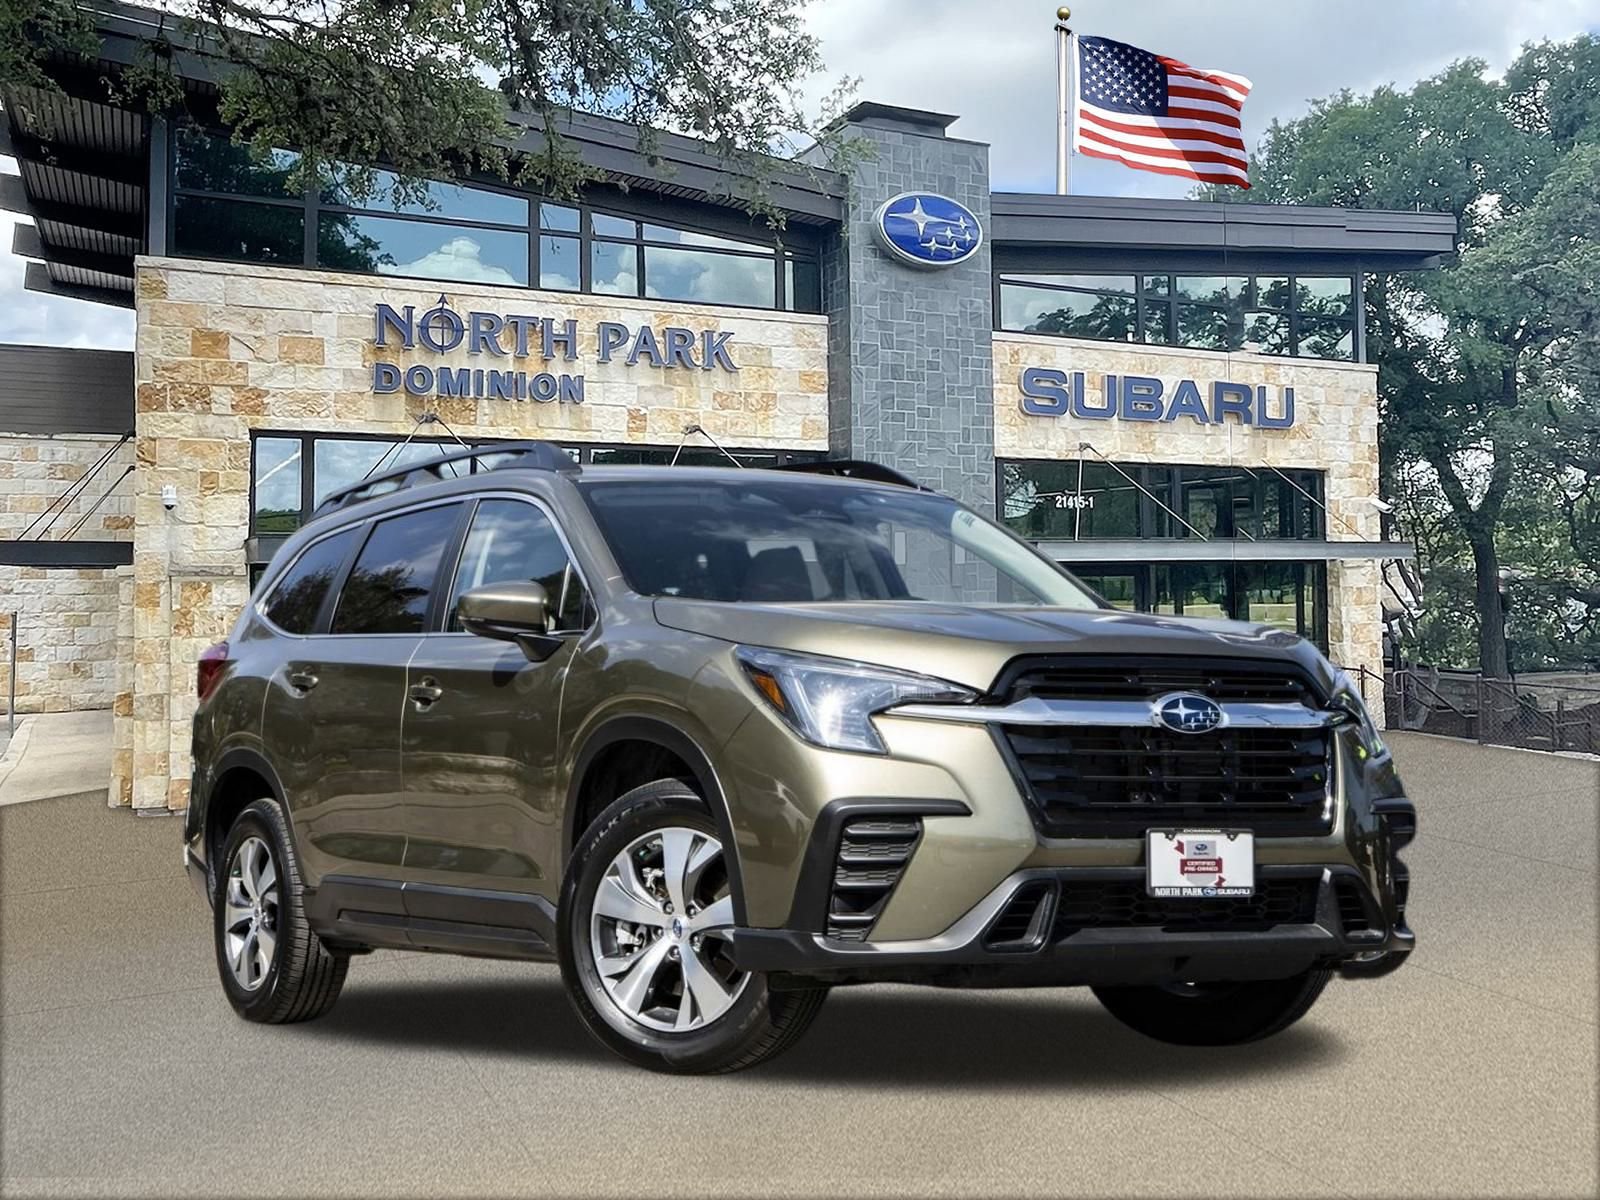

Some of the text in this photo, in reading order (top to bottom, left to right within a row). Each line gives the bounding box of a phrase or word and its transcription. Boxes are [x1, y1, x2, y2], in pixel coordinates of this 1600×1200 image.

[374, 293, 740, 372] NORTH PARK
[373, 362, 585, 403] DOMINION
[1018, 367, 1294, 429] SUBARU
[1055, 495, 1094, 509] 21415-1
[1154, 887, 1180, 896] NORTH
[1182, 887, 1203, 896] PARK
